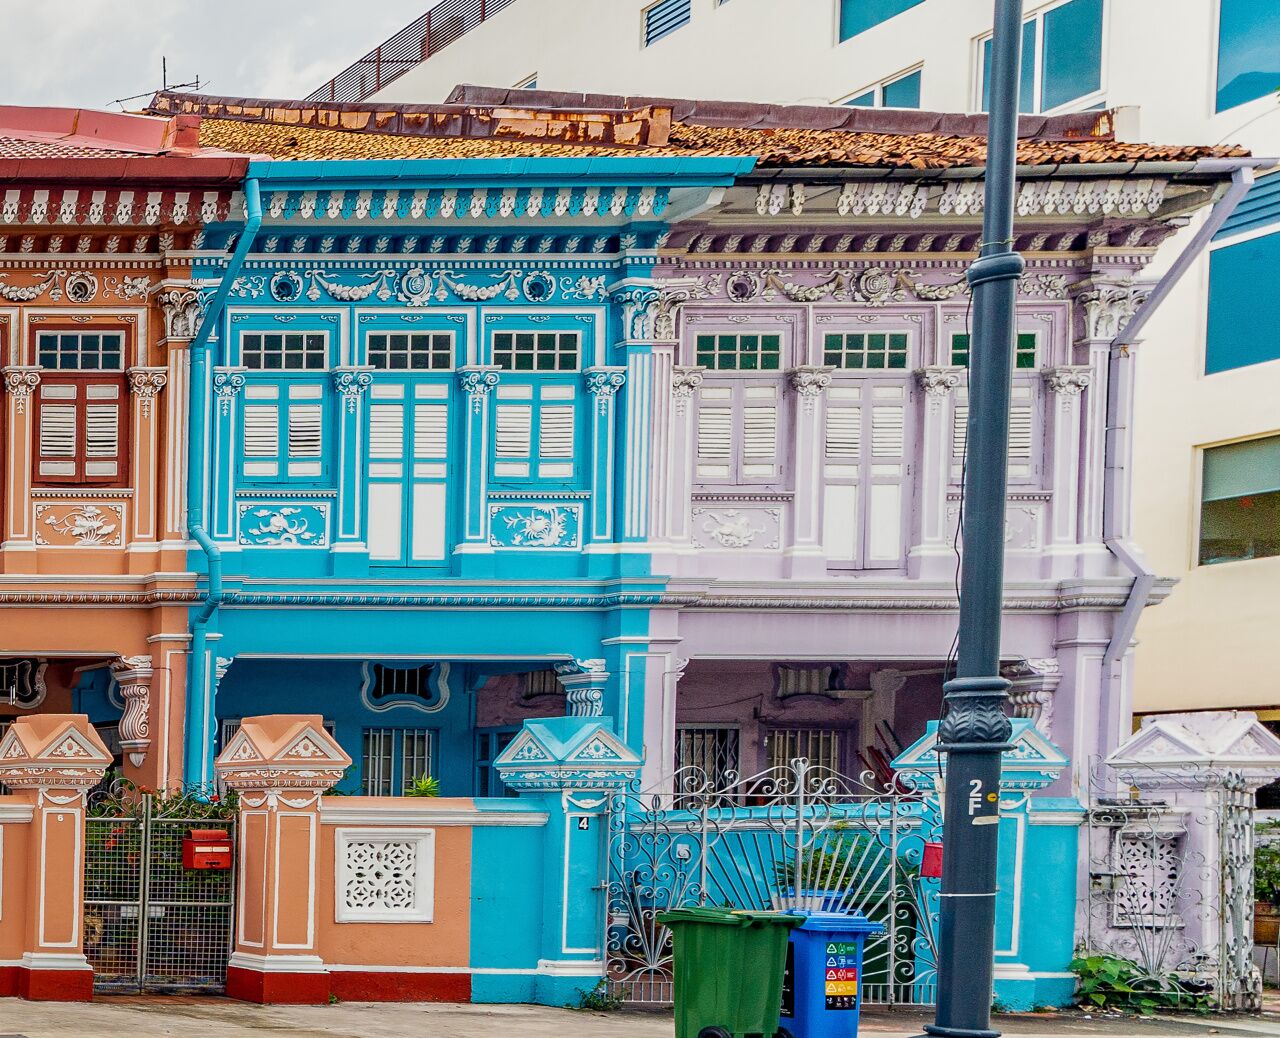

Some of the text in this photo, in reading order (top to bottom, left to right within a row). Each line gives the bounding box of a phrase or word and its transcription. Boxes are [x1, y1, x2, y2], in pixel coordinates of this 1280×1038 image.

[969, 779, 983, 798] 2
[968, 798, 982, 816] F
[57, 814, 64, 822] 6
[579, 817, 589, 830] 4
